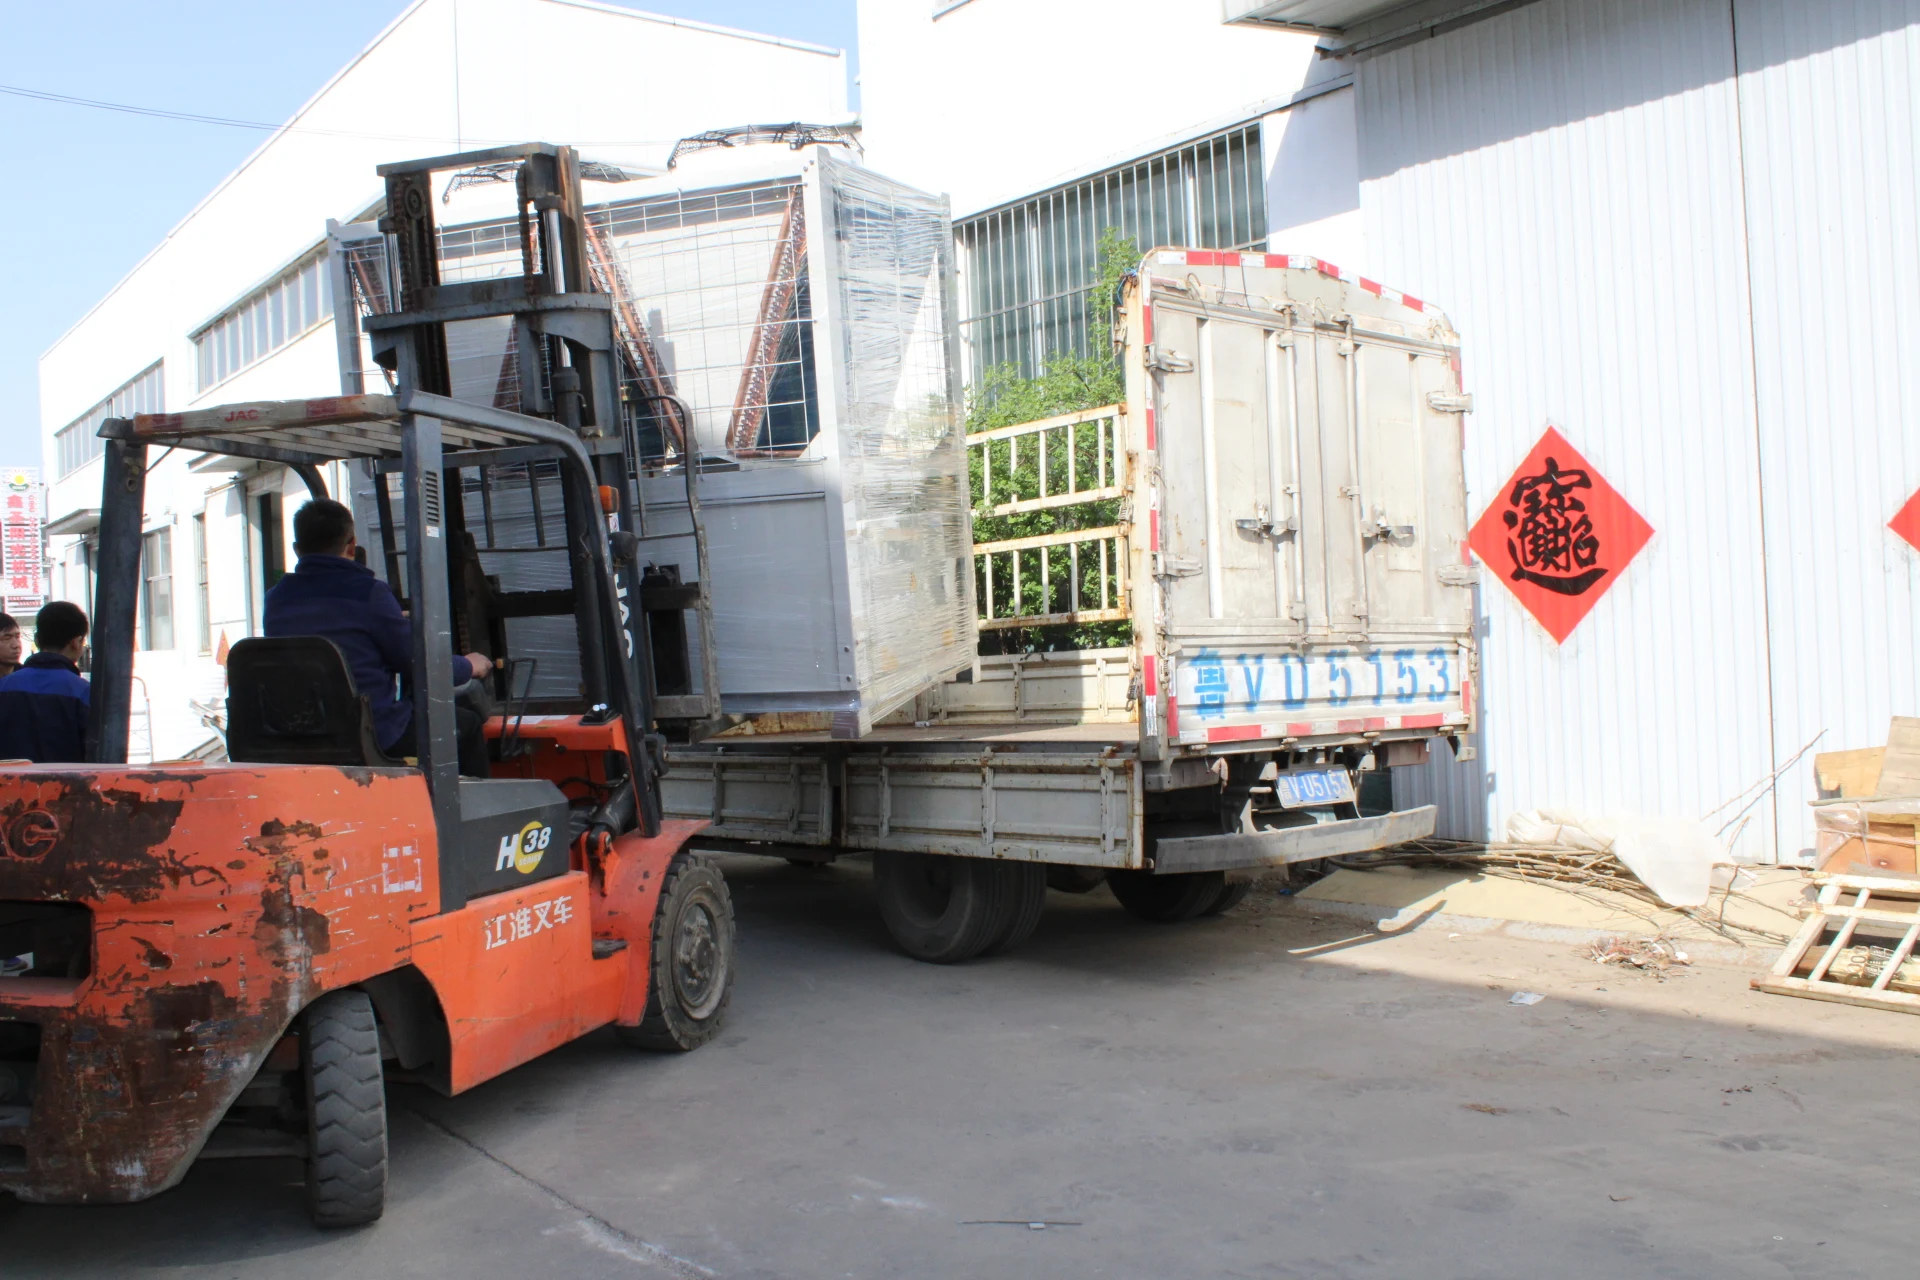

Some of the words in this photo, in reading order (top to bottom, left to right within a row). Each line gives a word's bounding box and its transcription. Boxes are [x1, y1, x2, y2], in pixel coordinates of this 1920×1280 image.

[226, 410, 258, 422] JAC
[485, 896, 573, 950] 江淮叉车
